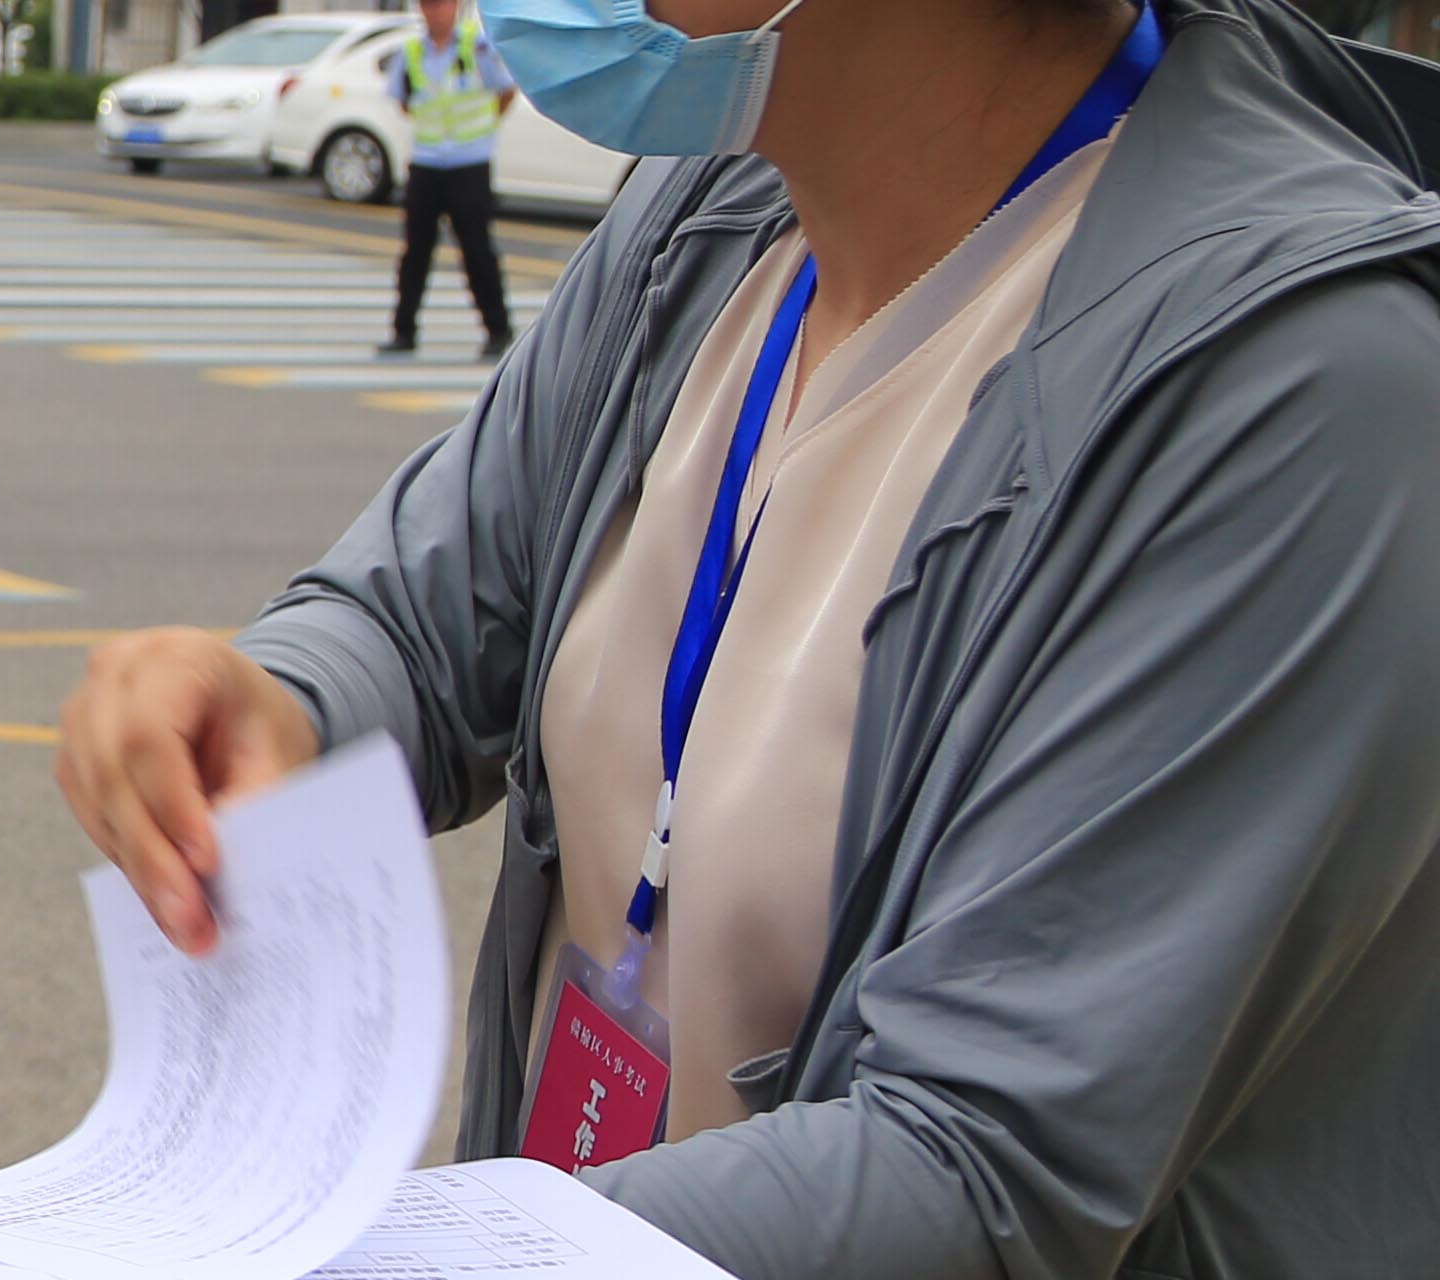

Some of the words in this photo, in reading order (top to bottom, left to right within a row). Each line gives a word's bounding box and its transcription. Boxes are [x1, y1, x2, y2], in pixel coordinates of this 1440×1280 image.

[569, 1016, 647, 1097] 赣榆区人事考试
[572, 1078, 607, 1175] 工作
